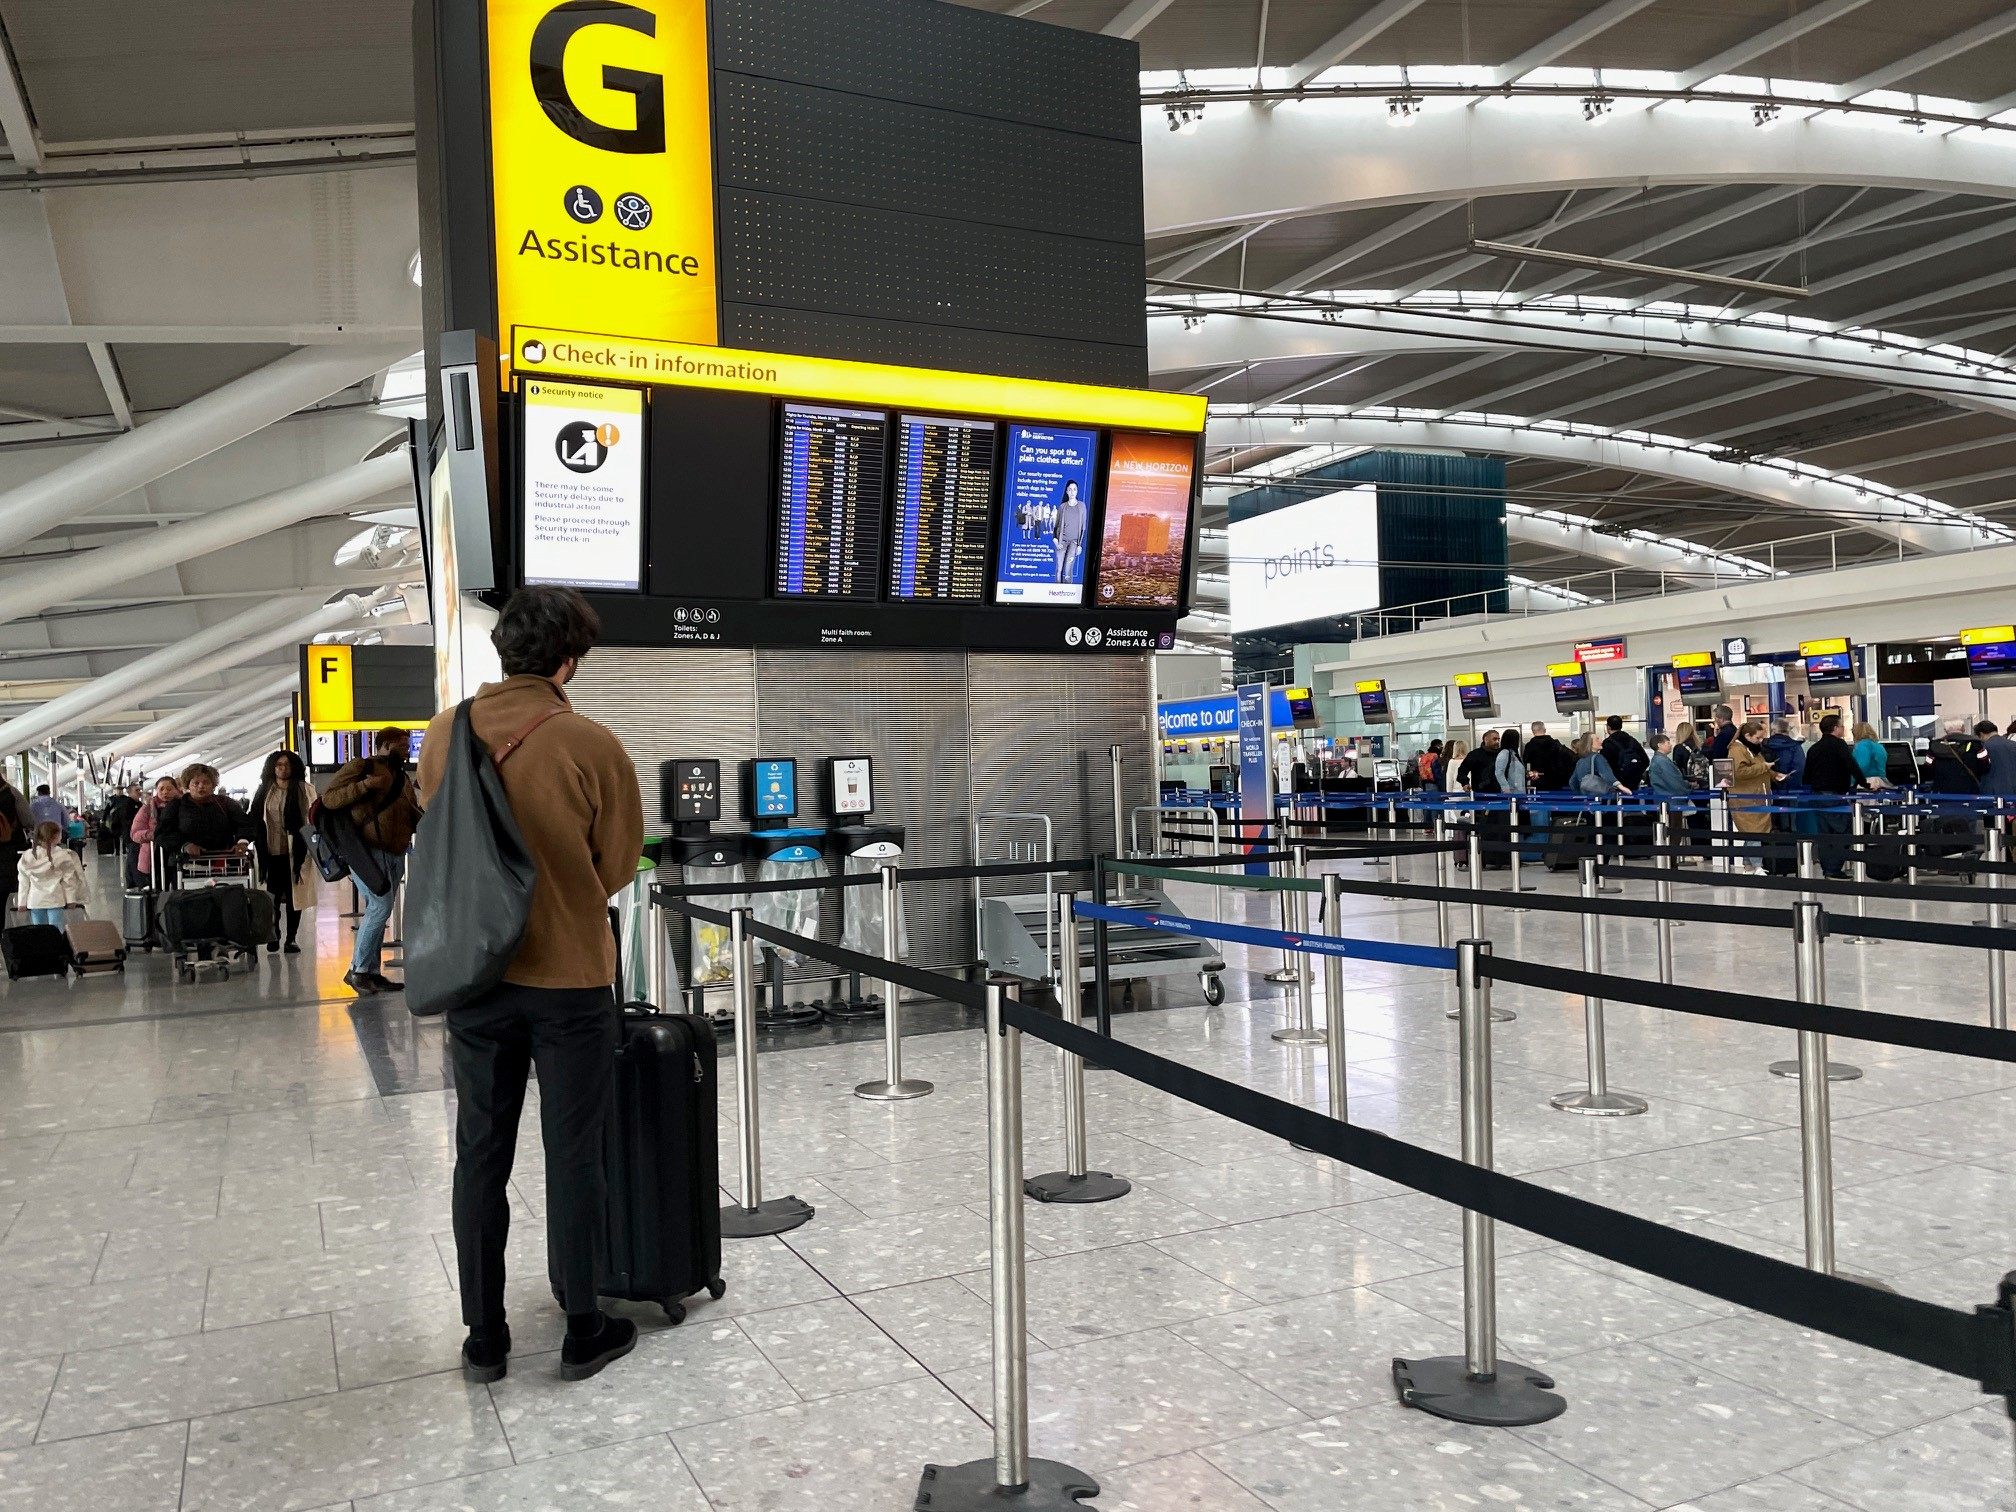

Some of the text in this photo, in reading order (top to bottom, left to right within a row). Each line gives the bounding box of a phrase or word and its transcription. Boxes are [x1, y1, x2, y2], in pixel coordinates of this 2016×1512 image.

[530, 0, 666, 154] G
[518, 229, 699, 277] Assistance
[552, 343, 778, 382] Check-in information
[542, 386, 604, 399] Security notice
[1020, 445, 1033, 453] Can
[1050, 449, 1064, 457] spot
[1019, 454, 1084, 466] plain clothes officer?
[1114, 460, 1188, 472] A NEW HORIZON
[535, 481, 558, 489] There
[560, 484, 578, 492] may
[535, 491, 567, 501] Security
[570, 493, 597, 502] delays
[535, 501, 601, 511] industrial action
[535, 515, 630, 527] Please proceed through
[535, 524, 620, 536] Security immediately
[535, 534, 589, 543] after check-in
[1264, 541, 1334, 589] points
[1049, 589, 1077, 597] Heathrow
[1106, 627, 1148, 637] Assistance
[1105, 638, 1155, 647] Zones A & G
[321, 657, 338, 684] F
[1159, 709, 1235, 729] elcome to our
[1241, 719, 1263, 728] CHECK-IN
[1303, 940, 1345, 951] BRITISH AIRWAYS
